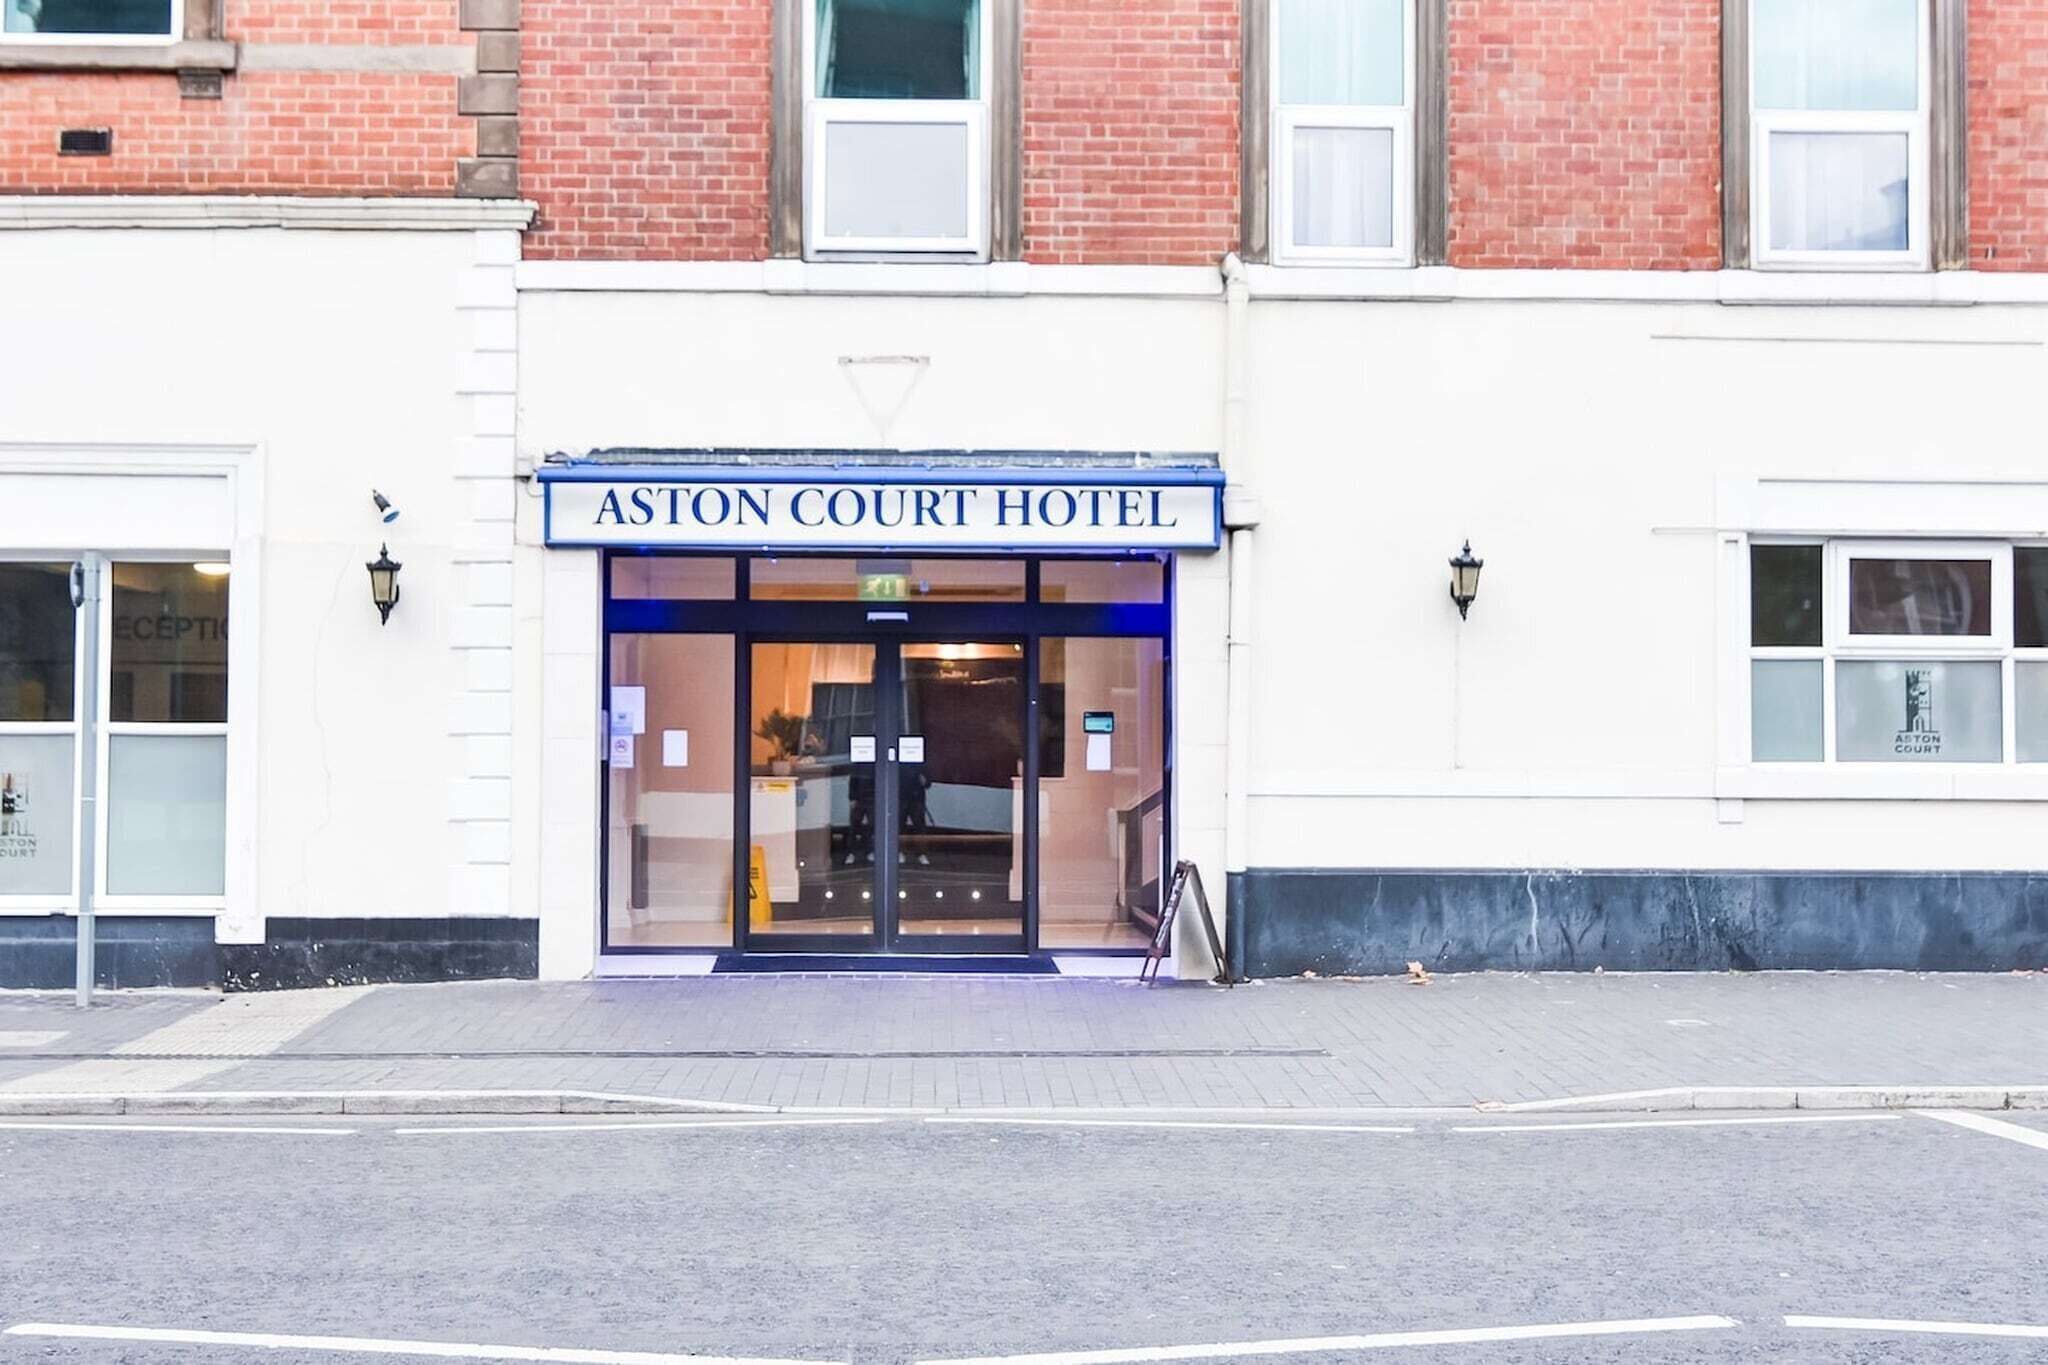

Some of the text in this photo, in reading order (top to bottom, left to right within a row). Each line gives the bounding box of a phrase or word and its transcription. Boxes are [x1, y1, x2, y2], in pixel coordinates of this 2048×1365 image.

[593, 487, 1178, 527] ASTON COURT HOTEL
[1895, 734, 1941, 743] ASTON
[1895, 745, 1941, 754] COURT
